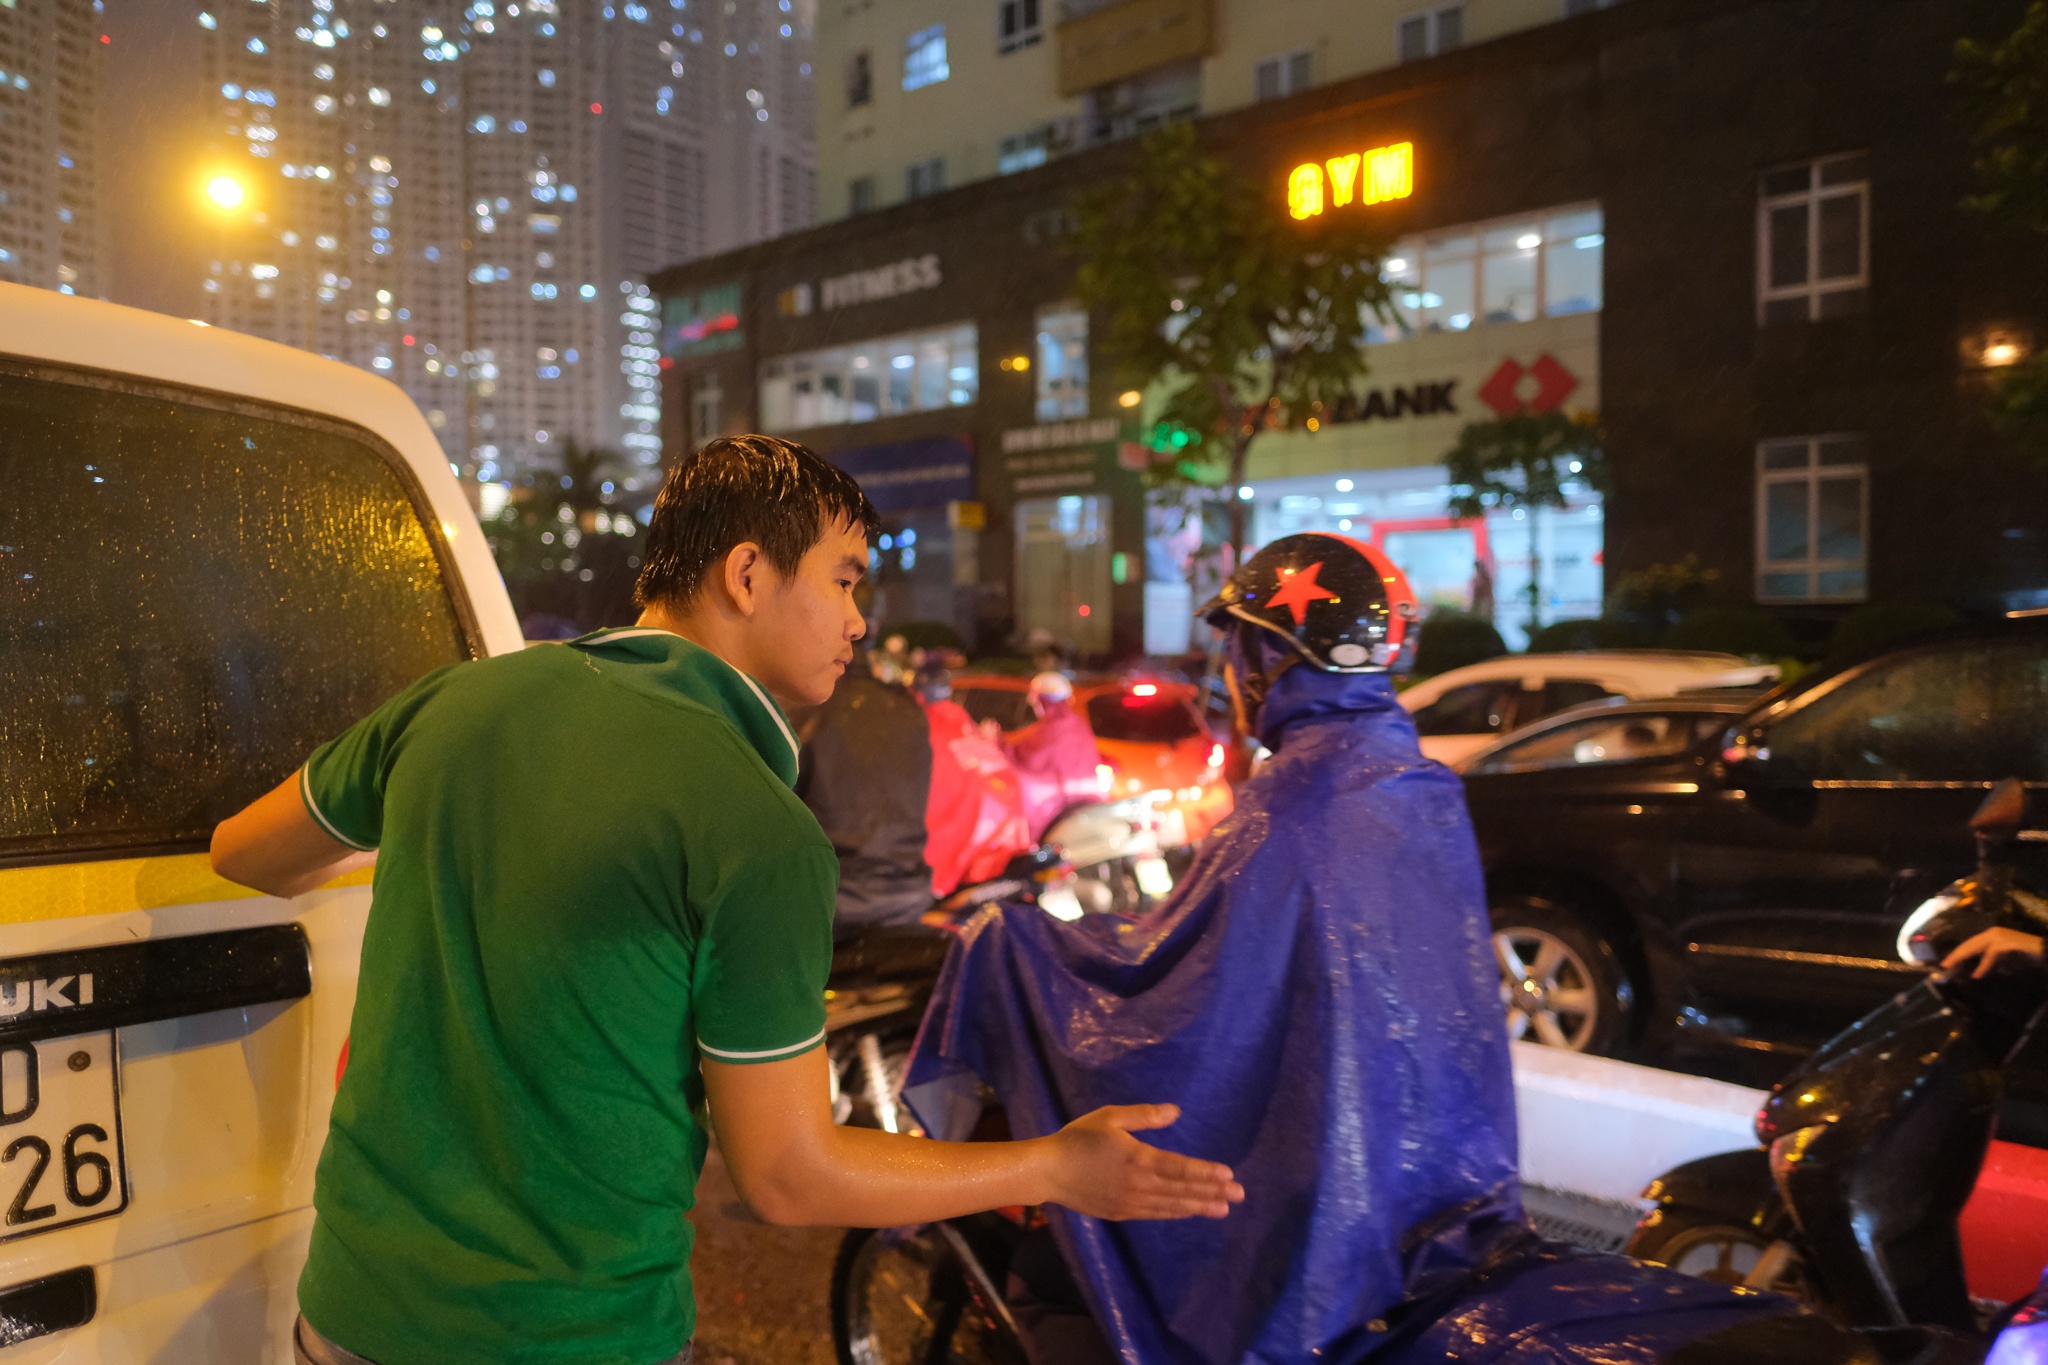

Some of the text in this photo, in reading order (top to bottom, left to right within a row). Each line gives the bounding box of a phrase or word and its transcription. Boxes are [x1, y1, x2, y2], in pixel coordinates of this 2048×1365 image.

[1288, 141, 1414, 221] GYM
[820, 254, 943, 311] FITNESS
[1, 1122, 113, 1227] 26
